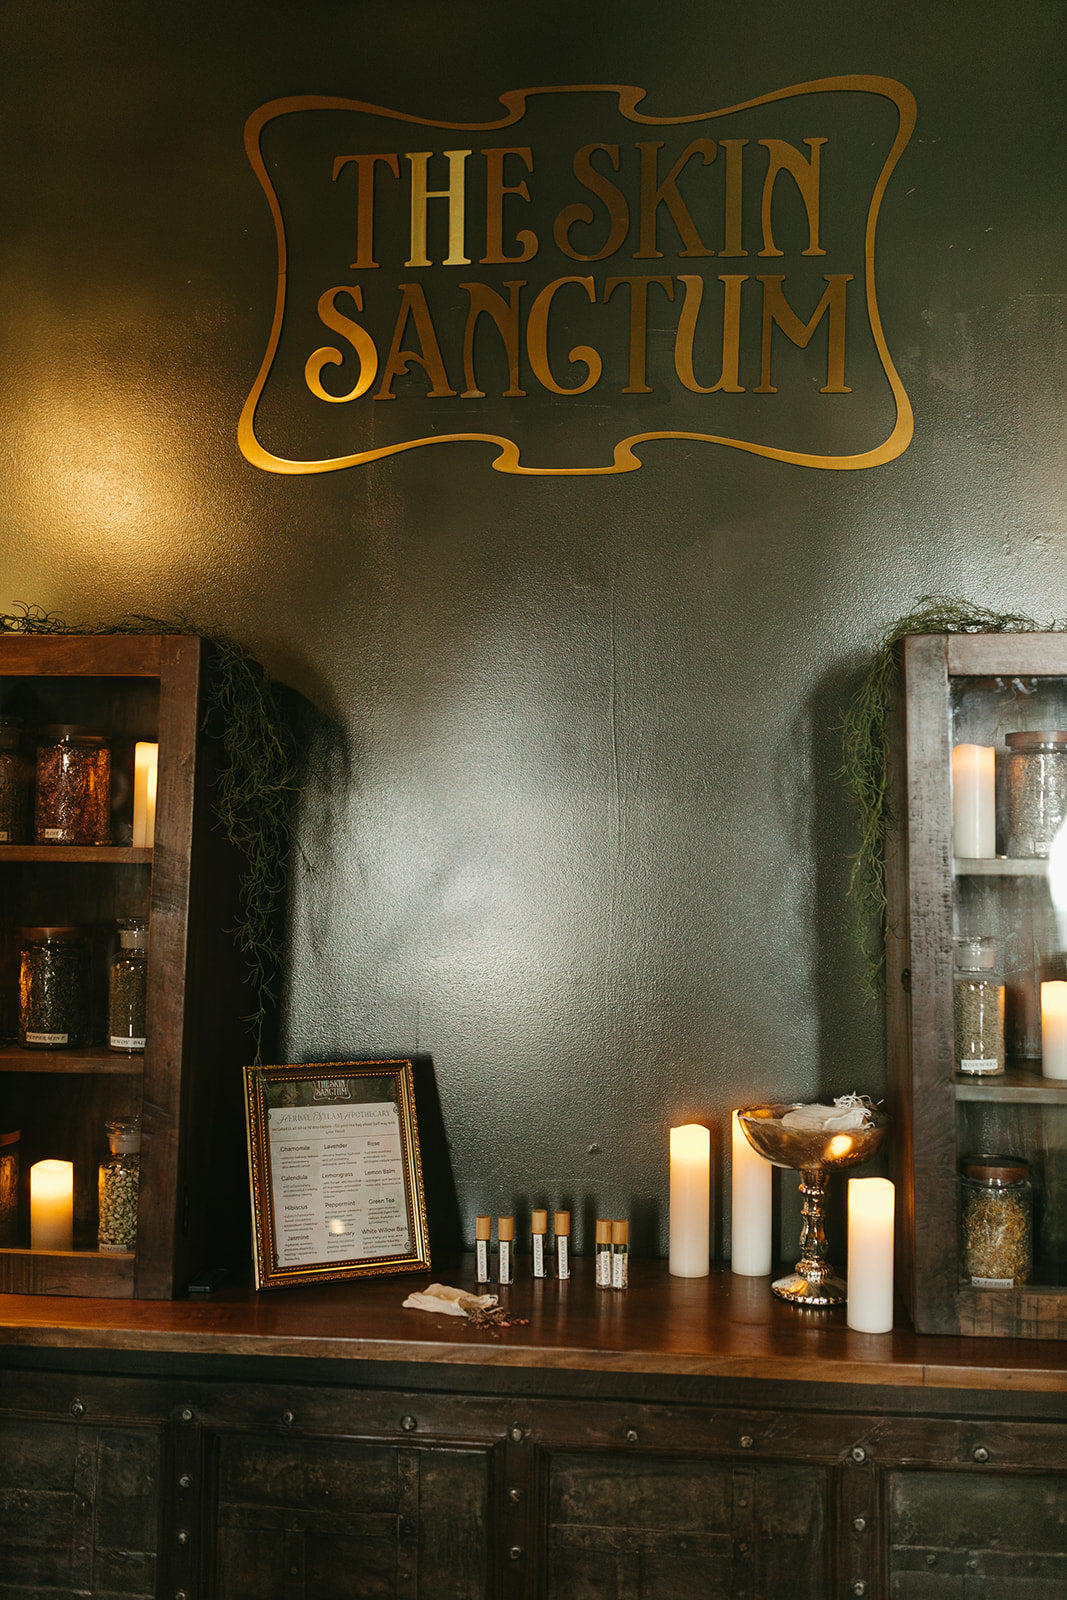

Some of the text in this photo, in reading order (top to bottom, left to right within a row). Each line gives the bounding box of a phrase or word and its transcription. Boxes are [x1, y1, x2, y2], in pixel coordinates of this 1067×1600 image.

[332, 137, 829, 269] THE SKIN
[304, 273, 855, 403] SANCTUM
[315, 1087, 347, 1096] SANCTUM
[281, 1174, 308, 1182] Calendula
[322, 1171, 353, 1179] Lemongrass
[325, 1200, 356, 1208] Peppermint
